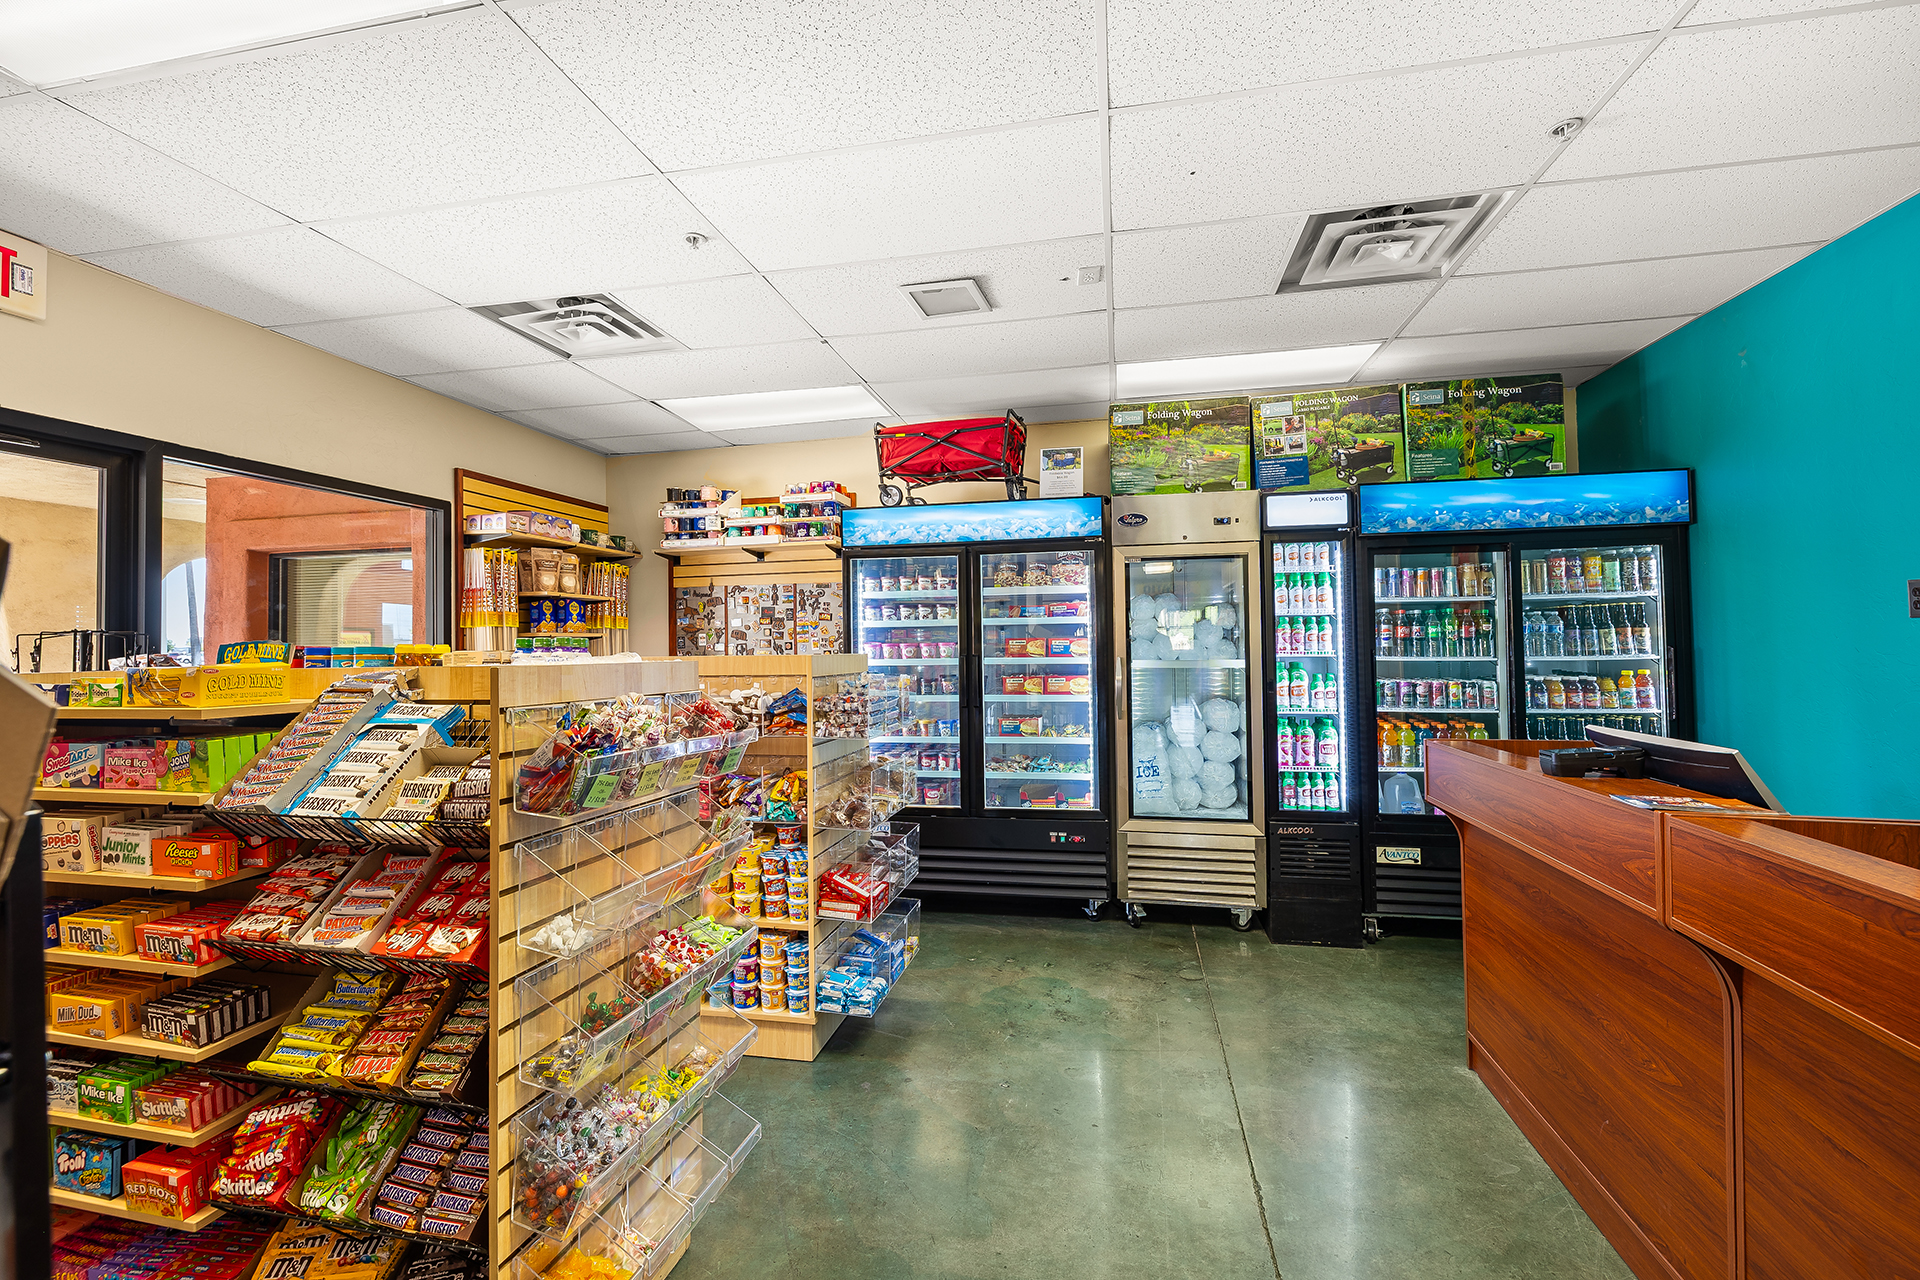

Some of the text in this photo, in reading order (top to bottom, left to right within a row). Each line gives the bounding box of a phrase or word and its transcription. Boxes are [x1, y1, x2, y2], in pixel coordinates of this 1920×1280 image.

[1487, 386, 1522, 397] Wagon
[1295, 394, 1359, 407] FOLDING WAGON
[1147, 408, 1213, 420] Folding Wagon
[224, 644, 285, 661] GOLD MINE
[207, 674, 284, 692] GOLD MINE
[71, 690, 88, 698] Trident
[92, 689, 110, 698] Trident
[389, 704, 433, 717] HERSHEY'S
[363, 730, 407, 742] HERSHEY'S
[108, 757, 148, 767] Mike Ike
[170, 753, 190, 767] JOLLY
[342, 751, 388, 765] HERSHEY'S
[65, 767, 87, 779] Original
[174, 769, 191, 779] SOUR
[429, 766, 464, 778] HERSHE
[1136, 765, 1160, 778] ICE
[320, 775, 366, 789] HERSHEY'S
[605, 779, 615, 787] Each
[400, 783, 443, 799] HERSHEY'S
[298, 796, 346, 812] HERSHEY'S
[444, 803, 488, 819] HERSHEY'S
[1277, 826, 1315, 835] ALKCOOL
[103, 837, 140, 853] Junior
[165, 842, 199, 859] Reese's
[122, 855, 146, 866] Mints
[1379, 848, 1420, 860] AVANTCO
[416, 896, 455, 913] KitKat
[336, 983, 378, 996] Butterfinger
[57, 1006, 75, 1023] Milk
[306, 1015, 350, 1029] Butterfinger
[362, 1030, 415, 1047] TWIX
[346, 1055, 402, 1077] TWIX
[81, 1085, 123, 1104] Mike Ike
[142, 1101, 187, 1118] Skittles
[246, 1098, 317, 1123] Skittles
[417, 1129, 457, 1147] SATISFIES
[57, 1150, 87, 1173] Trolli
[402, 1145, 445, 1165] SATISFIES
[126, 1183, 146, 1195] RED
[148, 1185, 178, 1204] HOTS
[219, 1177, 275, 1196] Skittles
[381, 1184, 420, 1206] SATISFIES
[434, 1193, 476, 1213] SNICKERS
[372, 1207, 410, 1229] SNICKERS
[422, 1219, 462, 1236] SATISFIES
